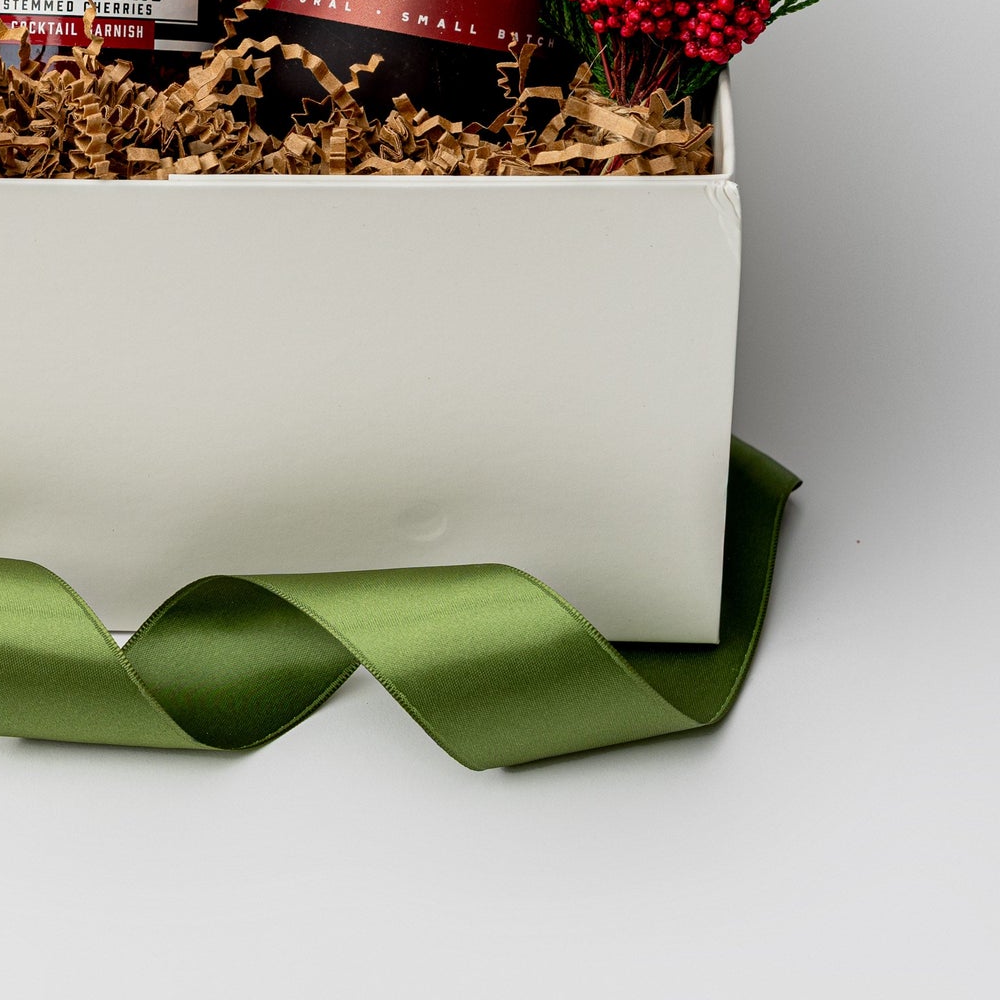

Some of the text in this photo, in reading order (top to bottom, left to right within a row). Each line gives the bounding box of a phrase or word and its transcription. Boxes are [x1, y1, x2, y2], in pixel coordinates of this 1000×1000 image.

[3, 0, 153, 15] STEMMED CHERRIES
[90, 23, 144, 38] ARNISH
[401, 11, 477, 35] SMALL
